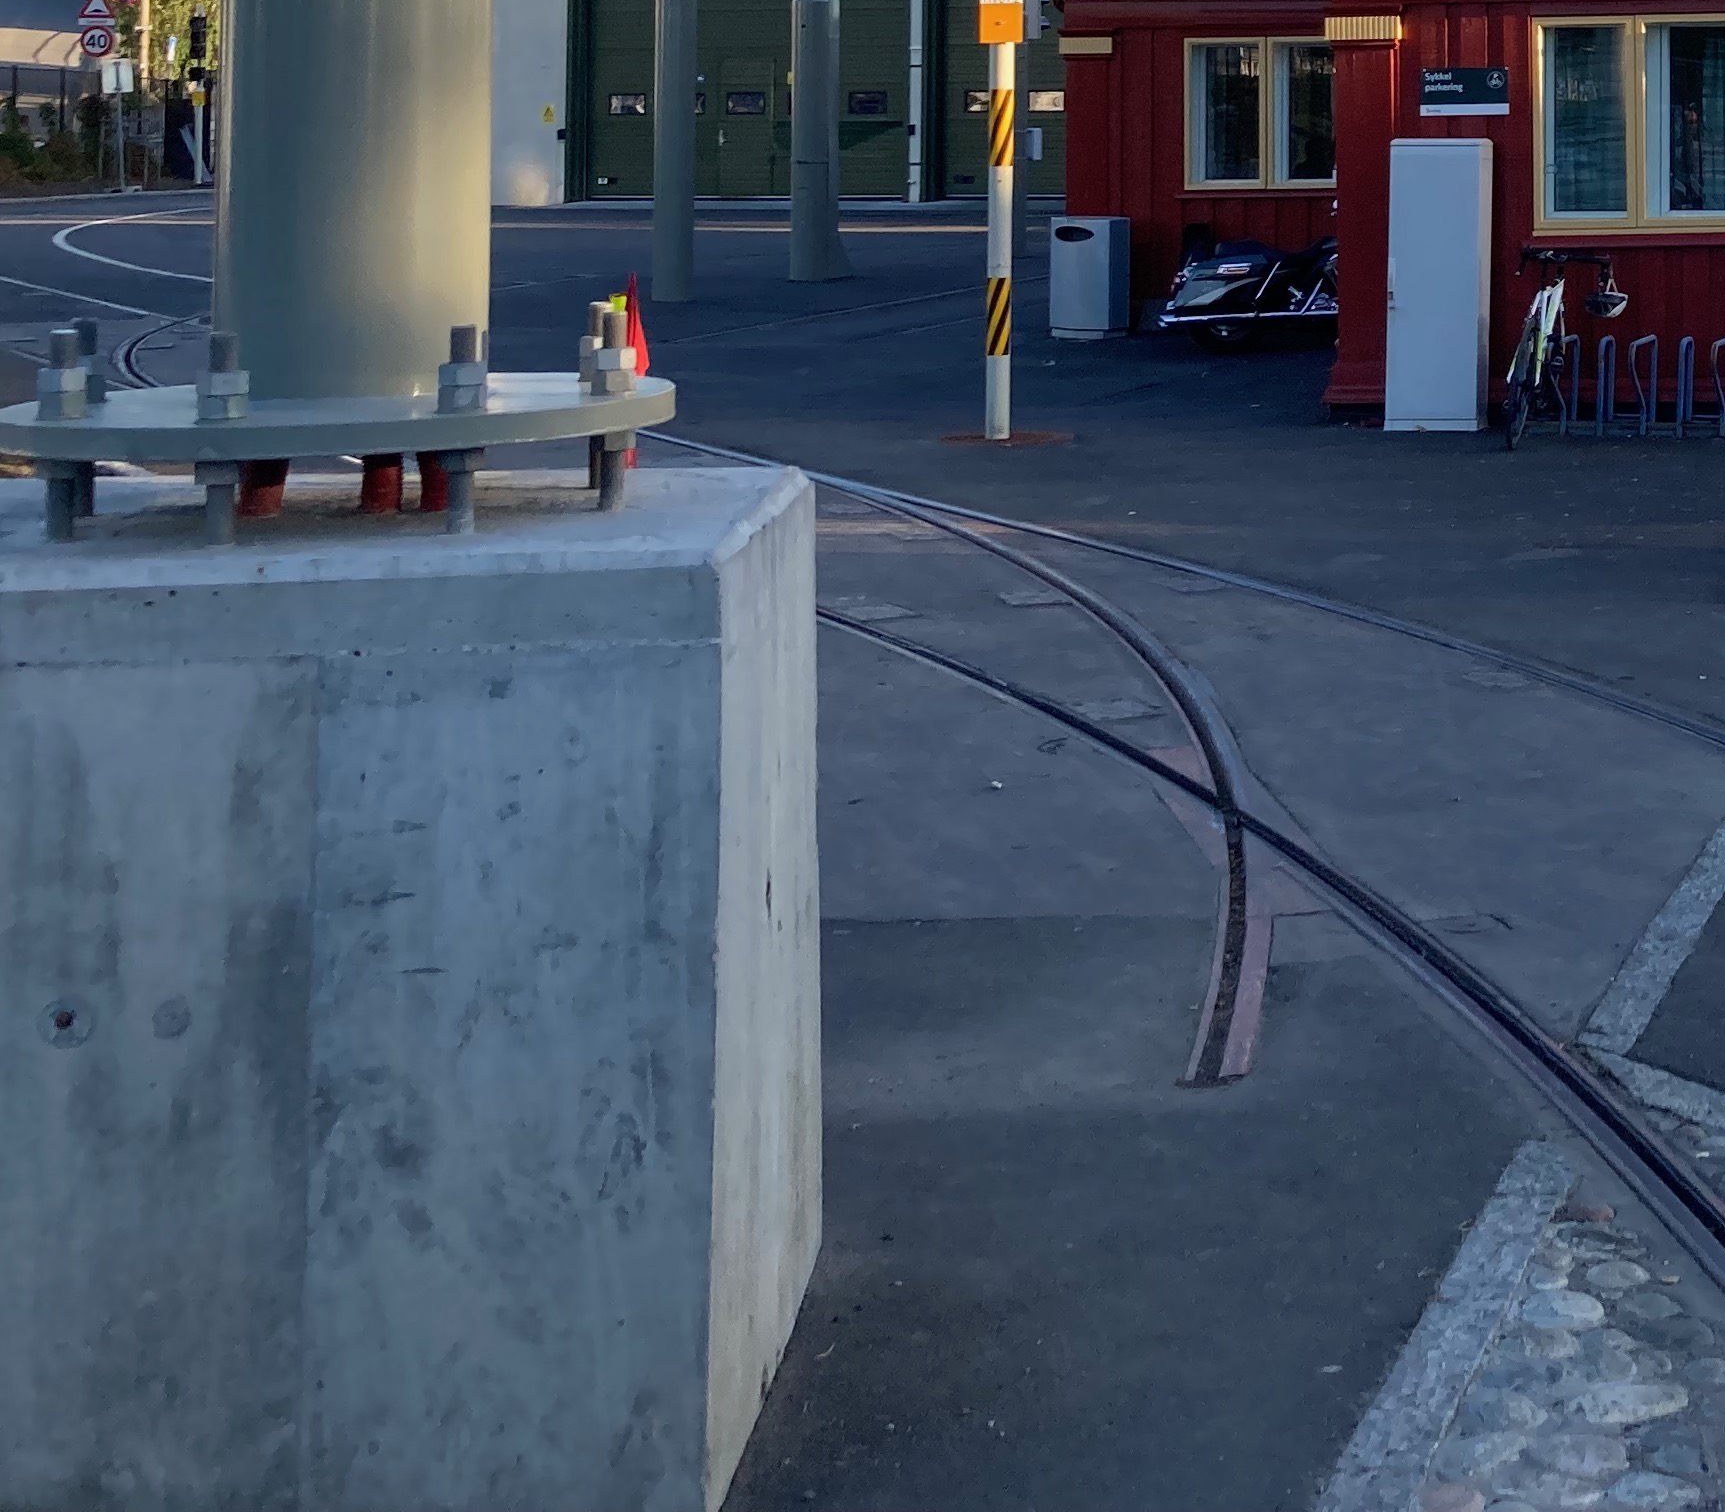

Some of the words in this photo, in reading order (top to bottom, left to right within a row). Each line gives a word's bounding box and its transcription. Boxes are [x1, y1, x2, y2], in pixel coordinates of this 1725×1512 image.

[86, 34, 107, 49] 40
[1424, 72, 1452, 82] Sykkel
[1424, 83, 1463, 93] parkering
